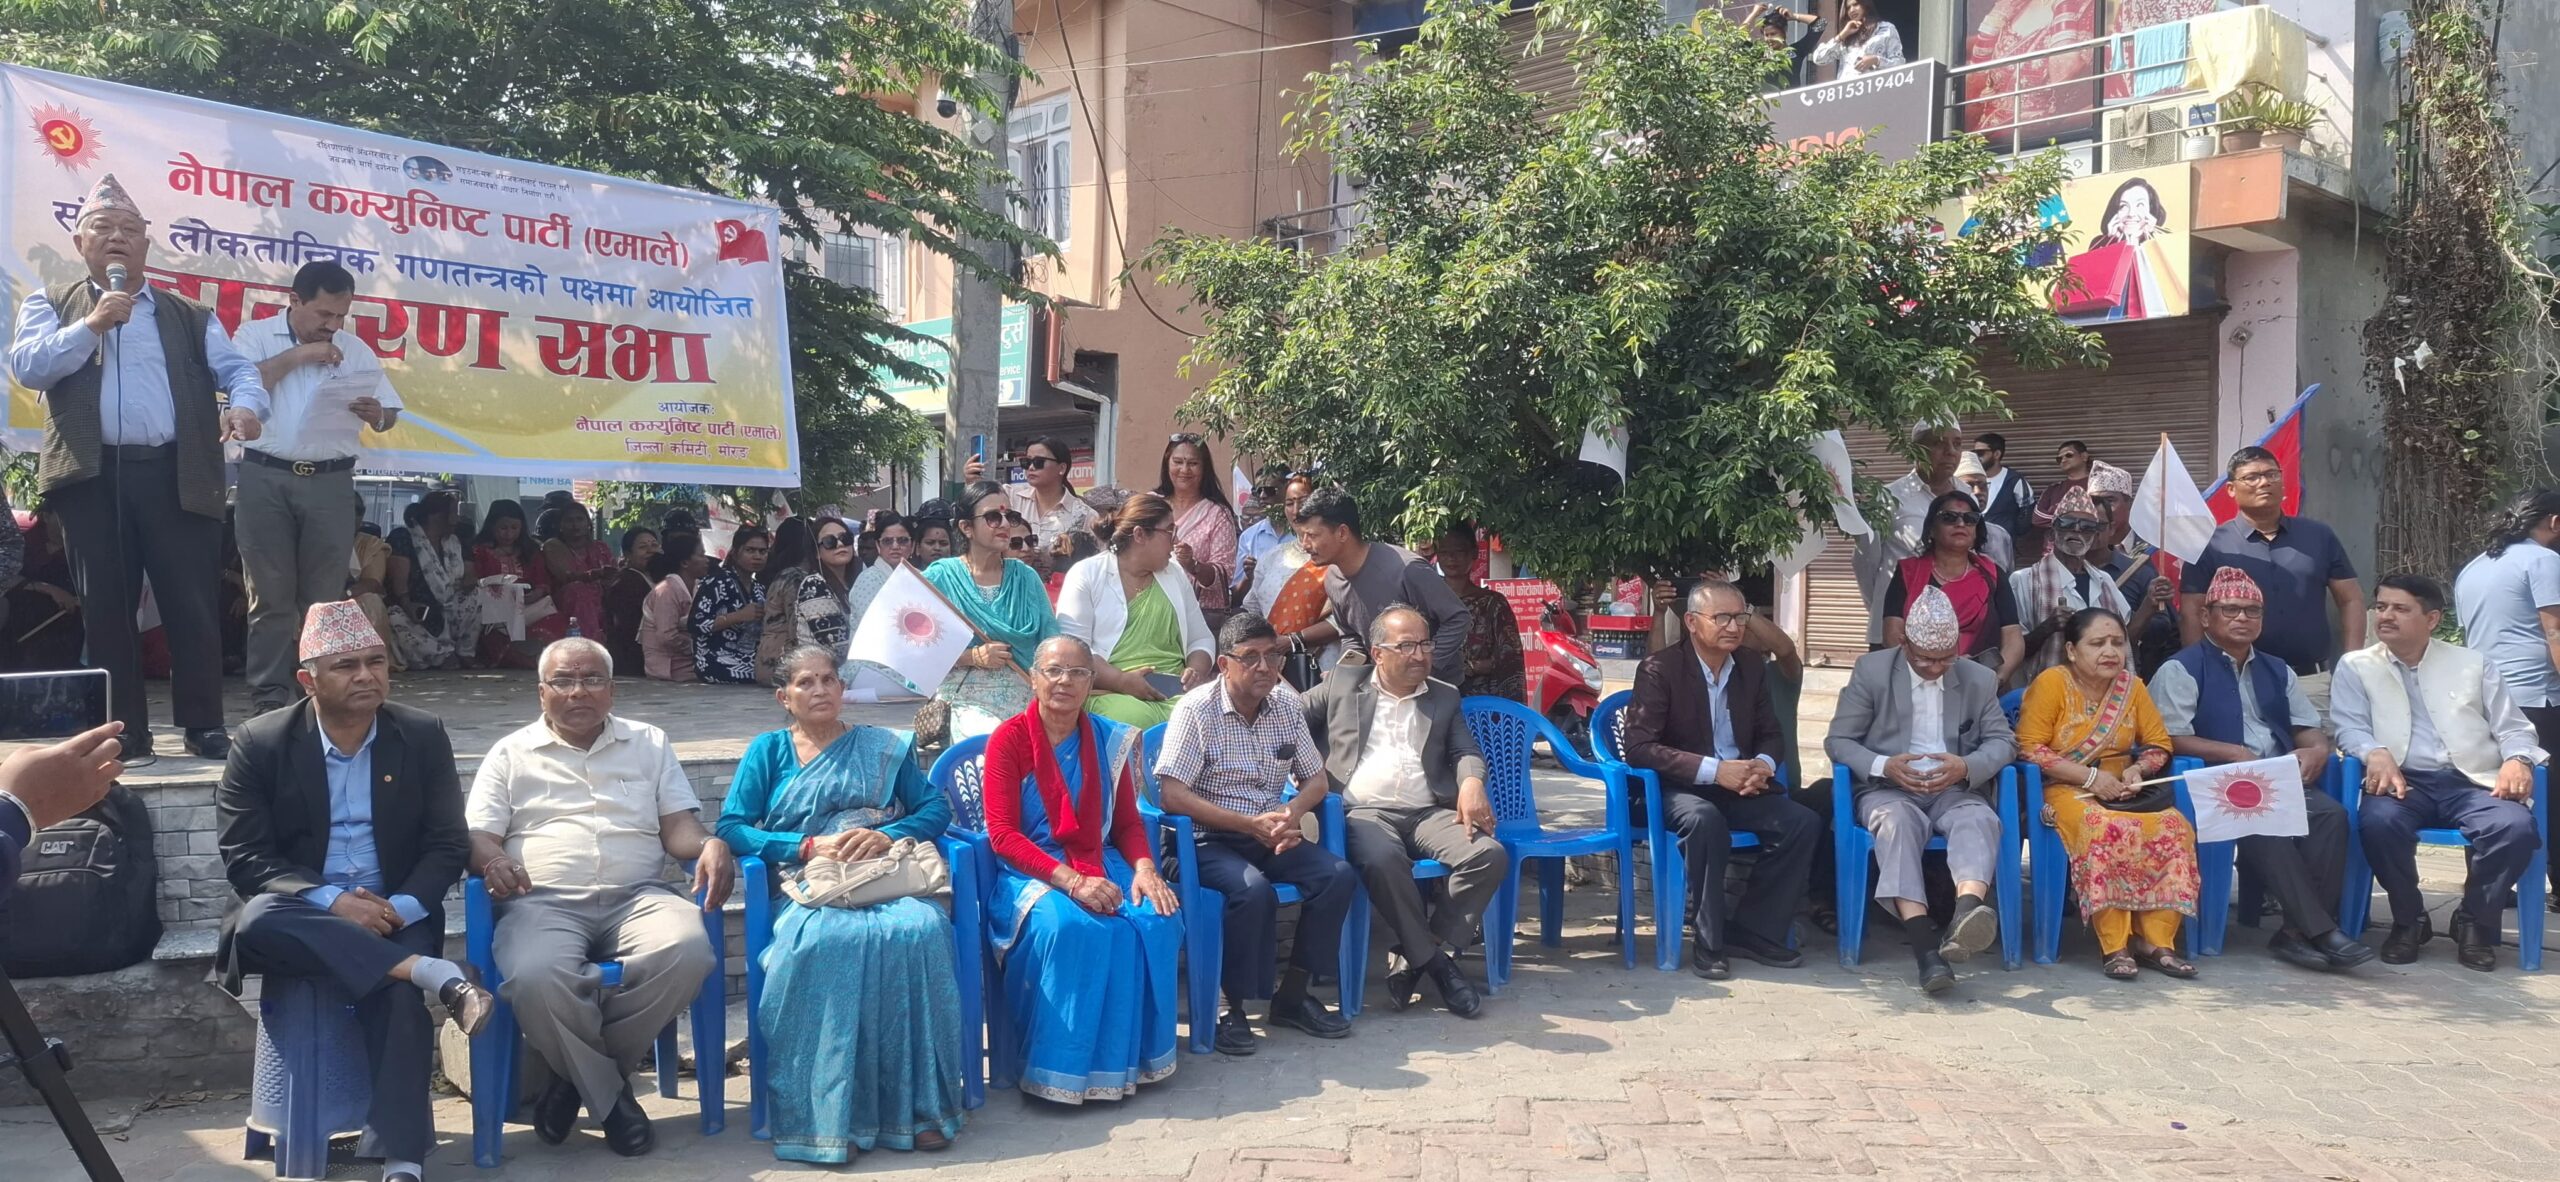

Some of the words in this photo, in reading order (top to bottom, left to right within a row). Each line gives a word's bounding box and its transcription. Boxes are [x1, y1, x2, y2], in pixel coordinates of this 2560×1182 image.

[1817, 69, 1915, 104] 9815319404
[168, 151, 295, 208] नेपाल
[308, 182, 490, 237] कम्युनिष्ट
[502, 213, 573, 250] पार्टी
[584, 226, 689, 269] (एमाले)
[395, 253, 548, 296] गणतन्त्रको
[561, 277, 637, 308] पक्षमा
[647, 286, 753, 318] आयोजित
[535, 315, 718, 384] सभा
[1000, 364, 1021, 376] ervice
[575, 416, 622, 433] नेपाल
[629, 417, 702, 436] कम्युनिष्ट
[707, 420, 736, 437] पार्टी
[740, 424, 782, 441] (एमाले)
[625, 437, 664, 454] जिल्ला
[40, 840, 75, 854] CAT
